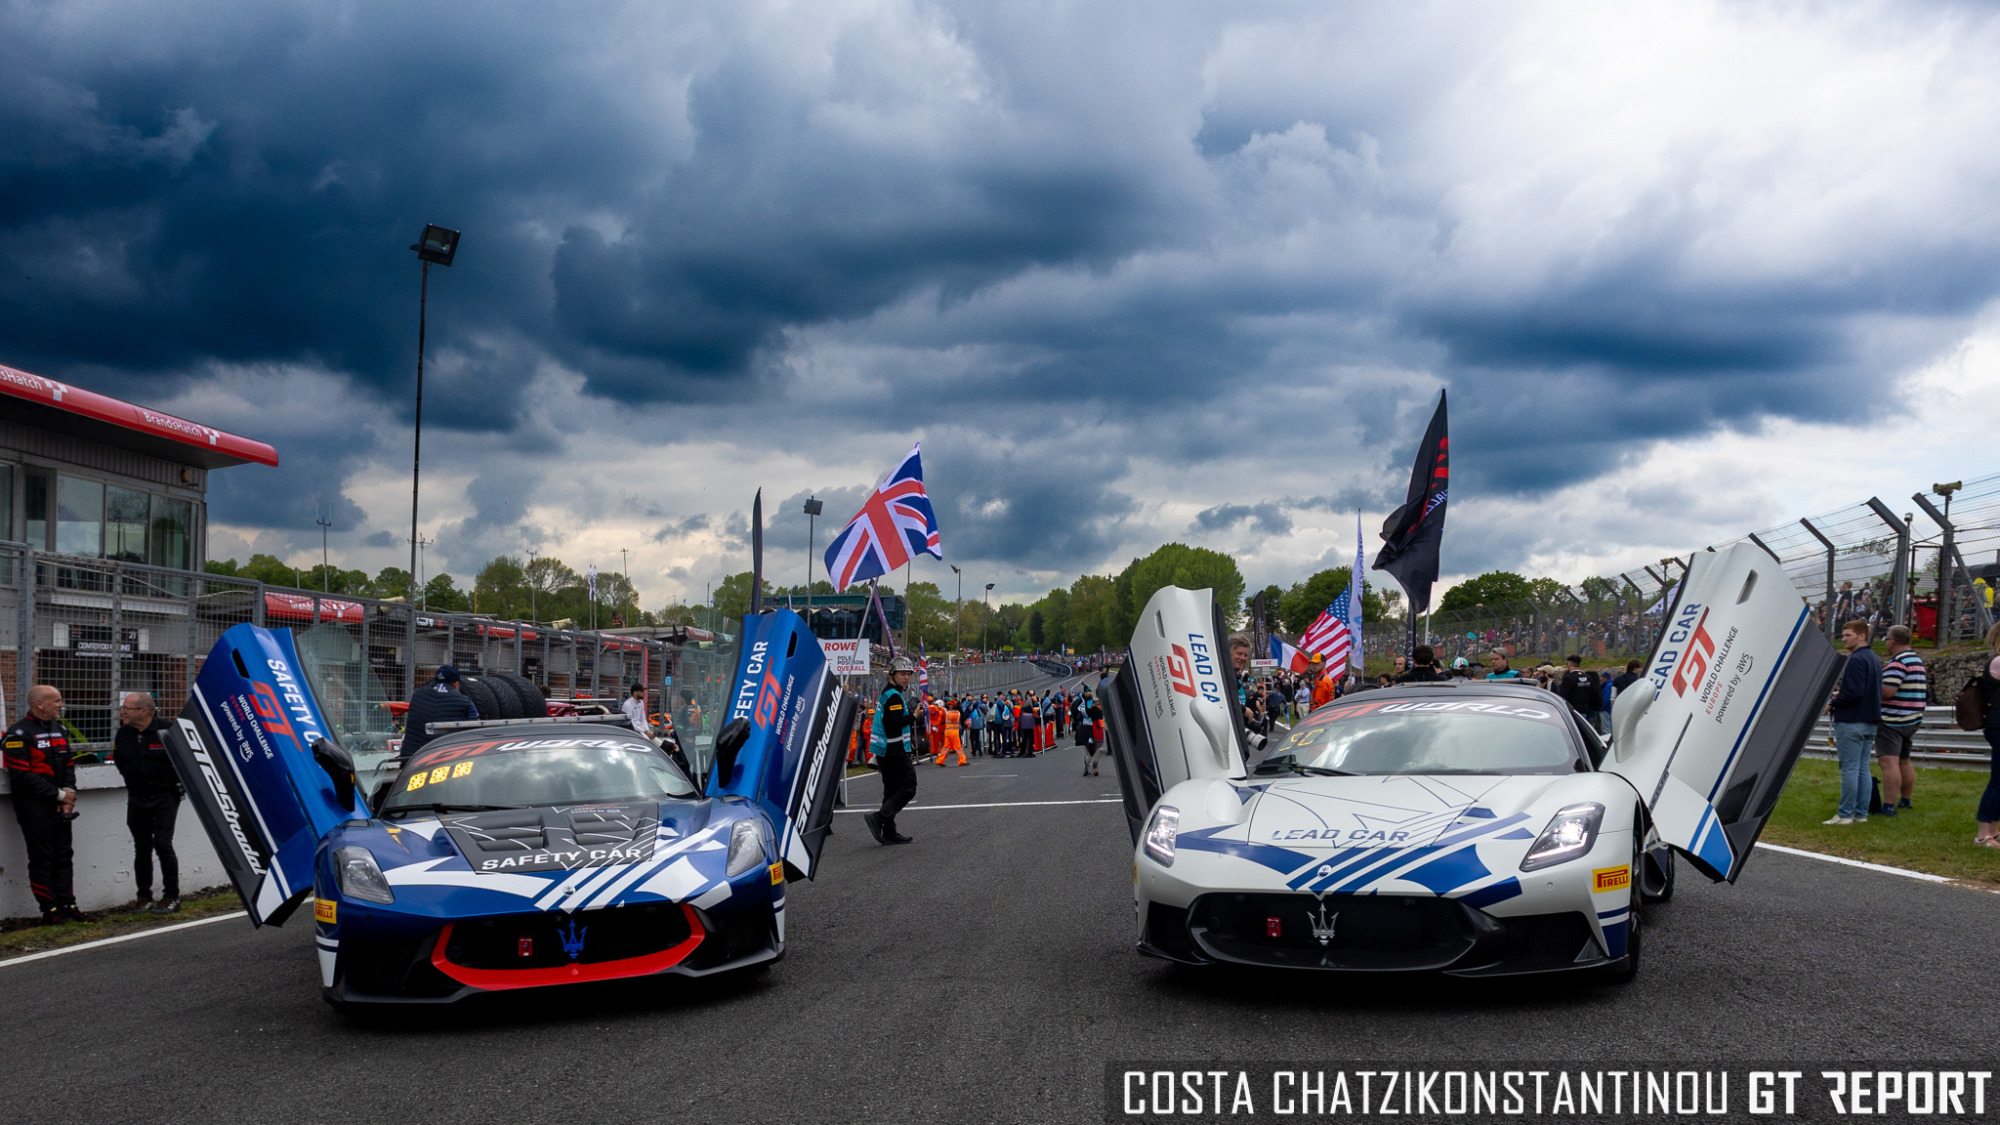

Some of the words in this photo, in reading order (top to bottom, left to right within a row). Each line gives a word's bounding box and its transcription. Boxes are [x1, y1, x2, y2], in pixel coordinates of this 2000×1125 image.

[0, 370, 43, 391] sHatch
[143, 411, 202, 437] BrandsHatch
[824, 642, 857, 651] ROWE
[1188, 633, 1213, 676] LEAD
[1650, 650, 1678, 702] EAD
[1669, 603, 1702, 643] CAR
[1672, 606, 1716, 699] GT
[1736, 652, 1752, 675] aws
[733, 679, 757, 720] FETY
[747, 641, 769, 674] CAR
[1166, 643, 1198, 698] GT
[1700, 672, 1718, 704] WORLD
[1713, 626, 1739, 674] CHALLENGE
[1732, 673, 1742, 686] by
[267, 659, 316, 726] SAFETY
[754, 655, 782, 731] GT
[1159, 655, 1168, 679] WORLD
[1164, 679, 1177, 717] CHALLENGE
[1200, 681, 1222, 706] CA
[1705, 681, 1724, 715] EUROPE
[220, 701, 241, 732] powered
[248, 681, 304, 752] GT
[775, 710, 786, 735] WORLD
[782, 673, 795, 711] CHALLENGE
[1379, 701, 1551, 720] WORLD
[1715, 686, 1736, 724] powered
[236, 726, 245, 741] by
[238, 694, 254, 720] WORLD
[250, 720, 274, 759] CHALLENGE
[240, 740, 254, 761] aws
[496, 739, 652, 752] WORLD
[176, 718, 268, 875] GT2Stradal
[1271, 829, 1341, 840] LEAD
[1349, 829, 1410, 841] CAR
[482, 851, 581, 870] SAFETY
[590, 849, 641, 860] CAR
[1597, 868, 1628, 888] PIRELLI
